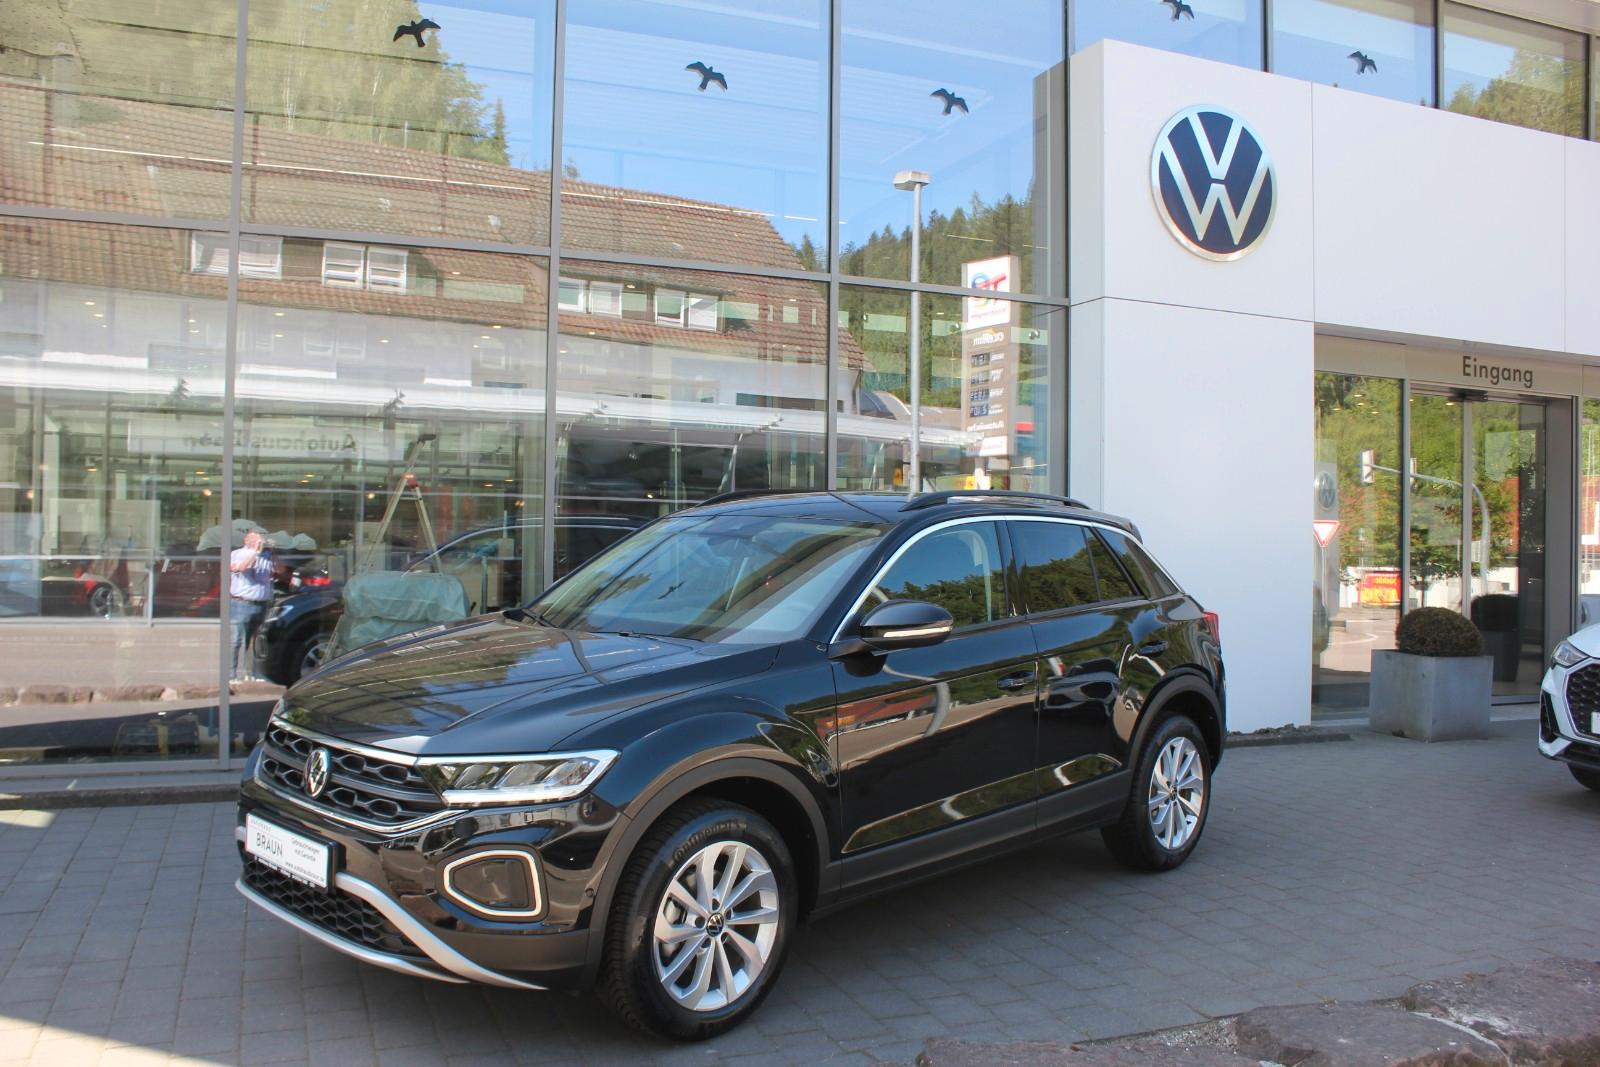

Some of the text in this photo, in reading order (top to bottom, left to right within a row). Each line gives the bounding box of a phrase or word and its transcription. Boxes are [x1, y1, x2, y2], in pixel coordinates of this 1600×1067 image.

[1153, 107, 1275, 256] VW
[1462, 355, 1534, 389] Eingang
[256, 831, 284, 857] BRAUN
